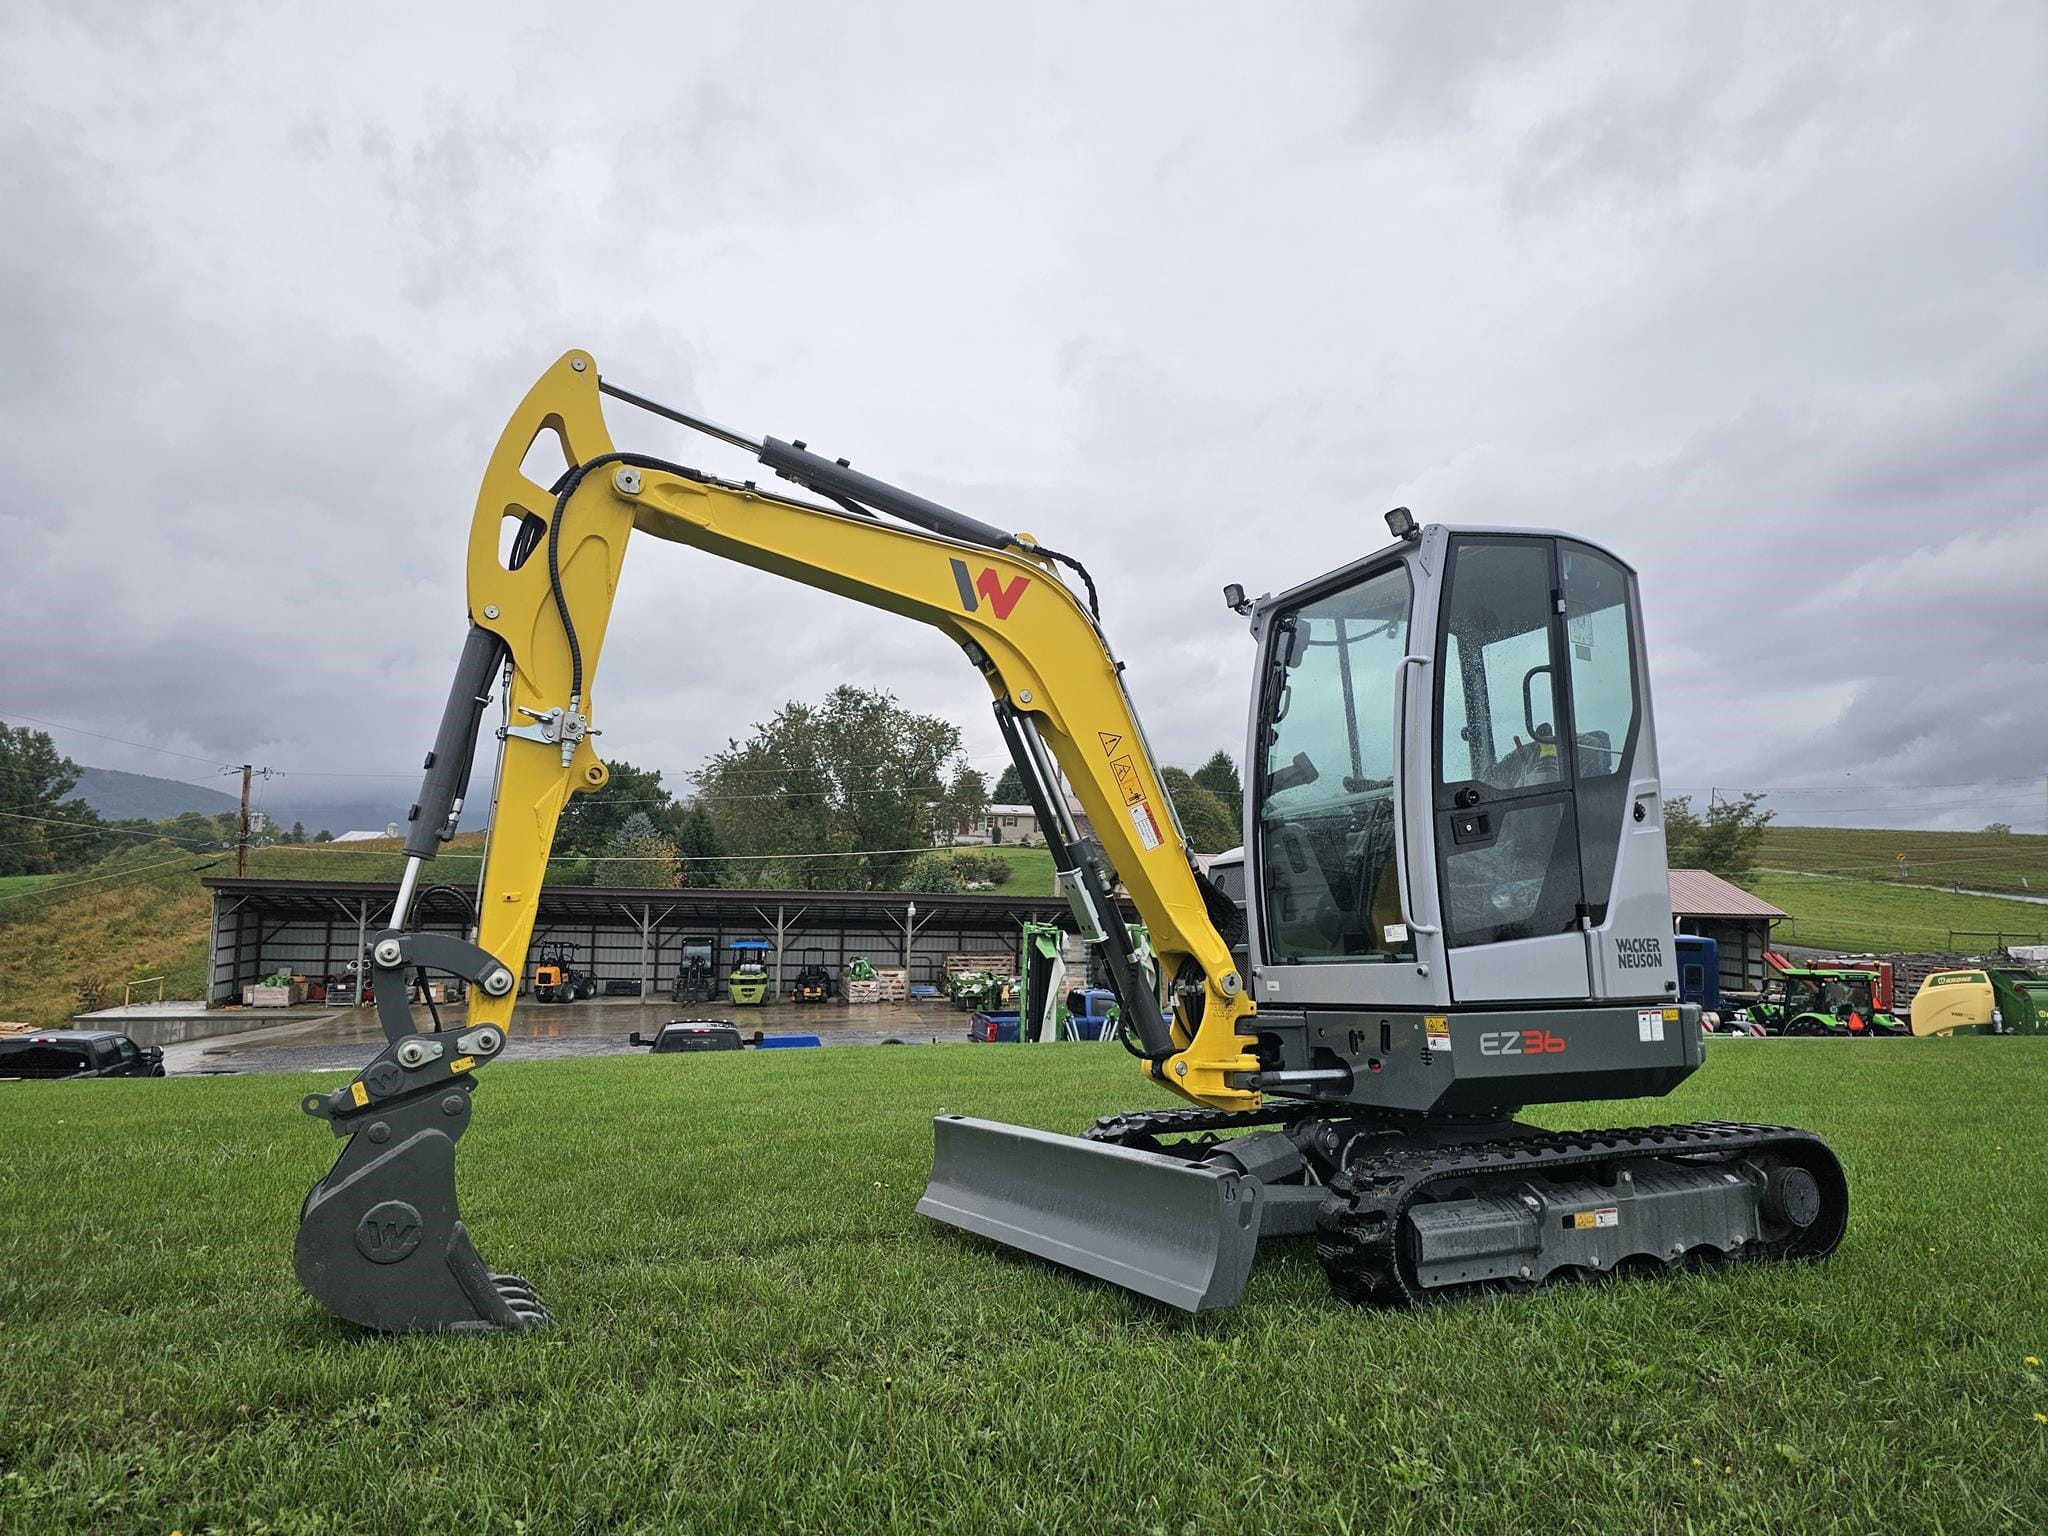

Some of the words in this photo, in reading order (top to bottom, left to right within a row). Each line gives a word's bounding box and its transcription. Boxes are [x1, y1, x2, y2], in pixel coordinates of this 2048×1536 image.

[1615, 938, 1661, 953] WACKER
[1618, 953, 1663, 968] NEUSON
[1480, 1030, 1566, 1055] EZ36
